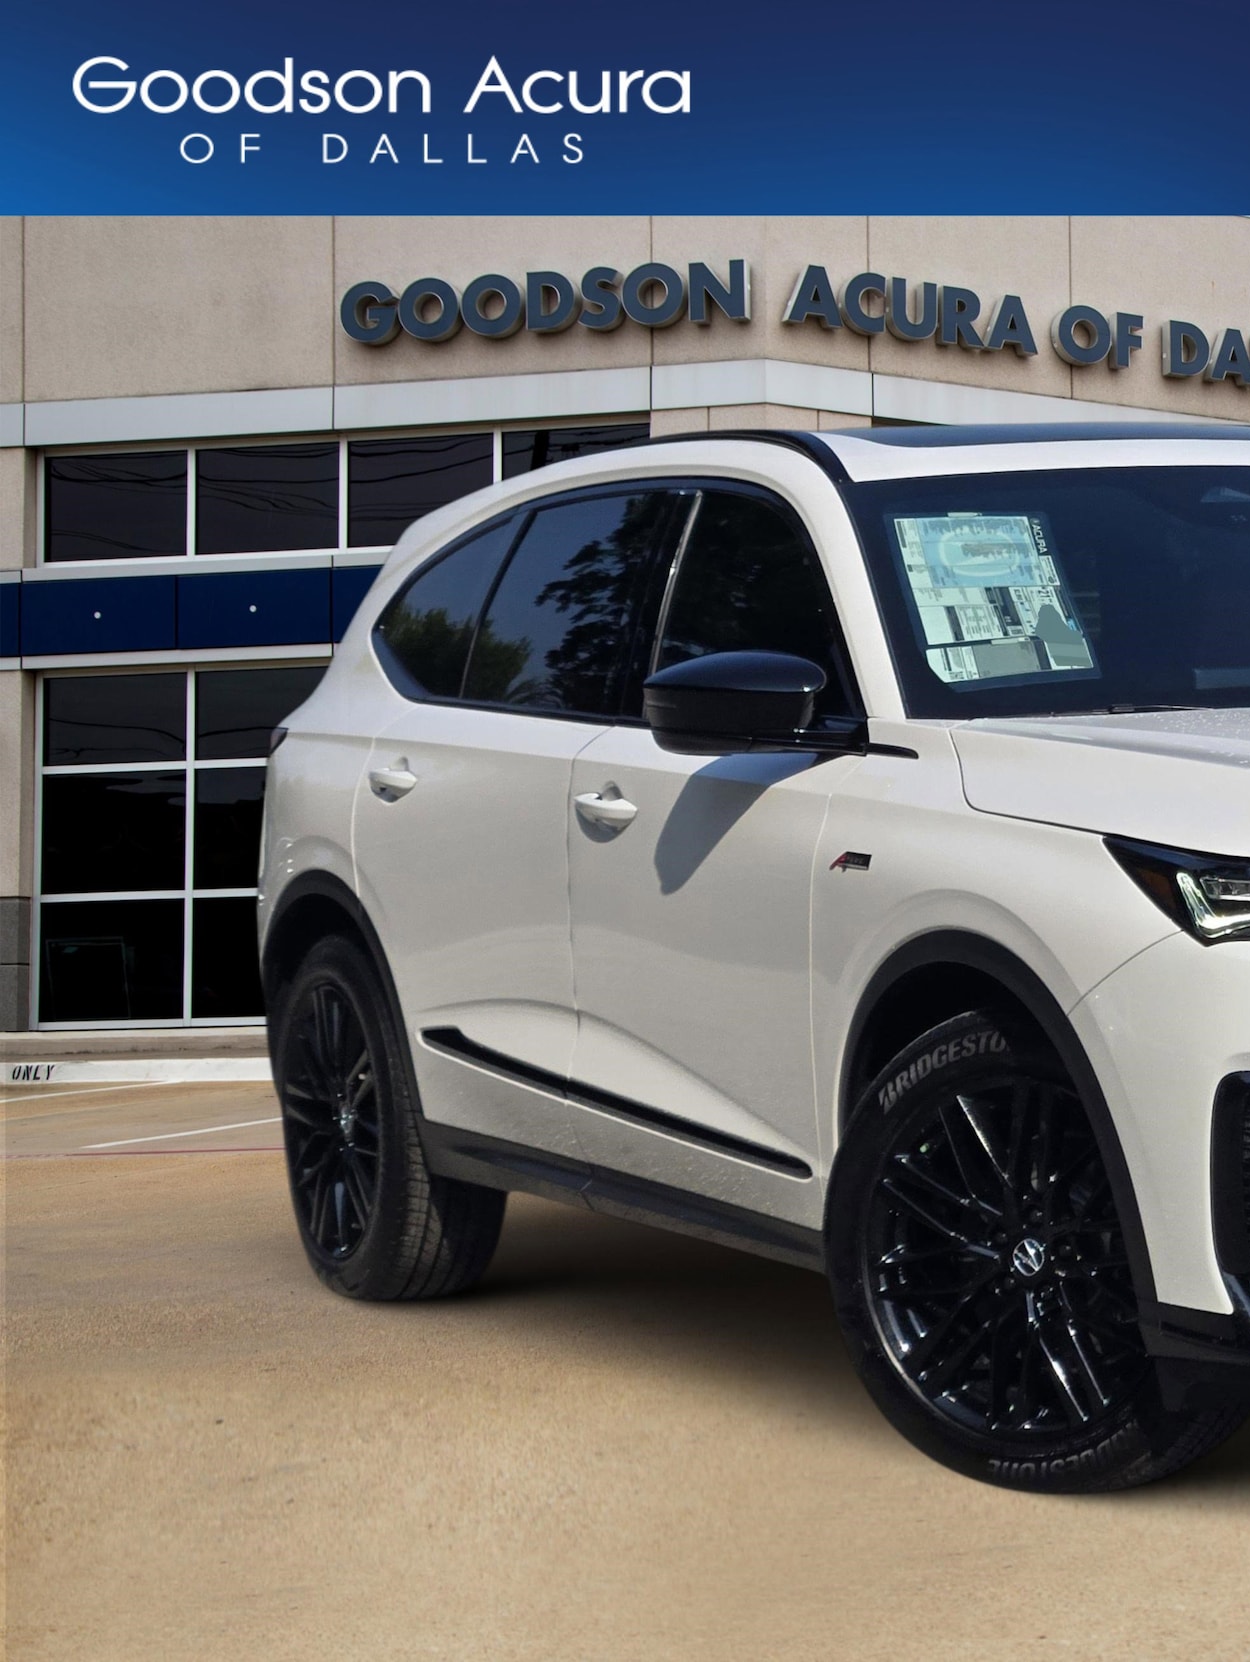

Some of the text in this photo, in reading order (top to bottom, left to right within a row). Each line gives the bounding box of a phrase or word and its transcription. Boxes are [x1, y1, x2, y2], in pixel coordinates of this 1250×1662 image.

[340, 257, 752, 347] GOODSON
[781, 264, 1039, 356] ACURA
[1051, 304, 1144, 371] OF
[1031, 524, 1048, 554] ACURA
[12, 1064, 55, 1081] ONLY
[877, 1030, 1011, 1116] BRIDGESTO
